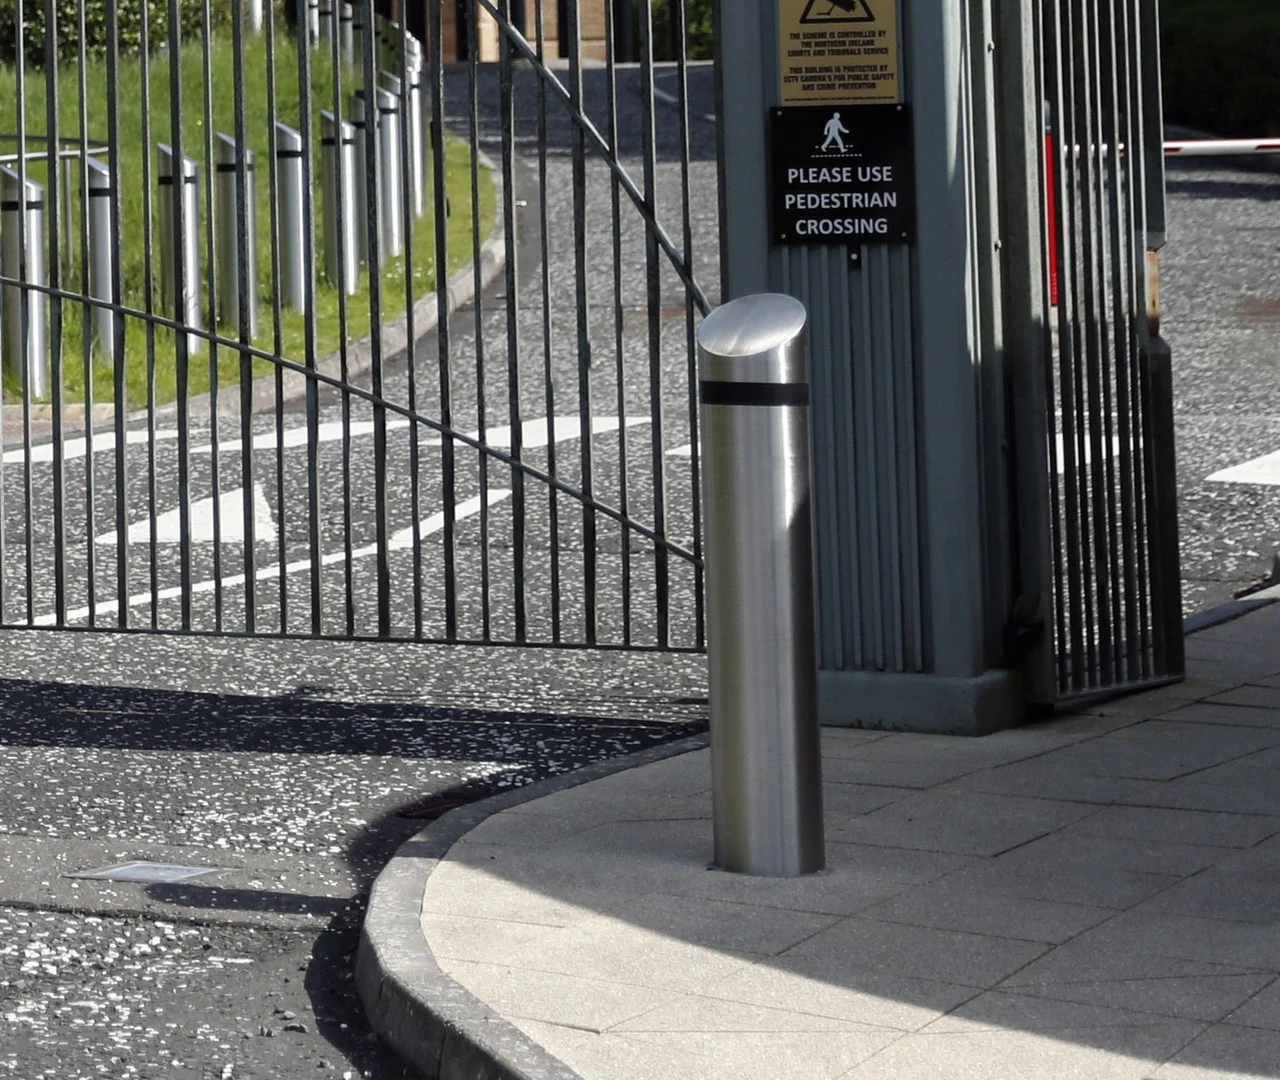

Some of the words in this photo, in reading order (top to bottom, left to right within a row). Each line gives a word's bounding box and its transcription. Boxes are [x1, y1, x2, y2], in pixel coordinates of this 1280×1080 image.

[788, 167, 852, 184] PLEASE
[858, 166, 892, 182] USE
[785, 192, 897, 209] PEDESTRIAN
[796, 218, 888, 235] CROSSING
